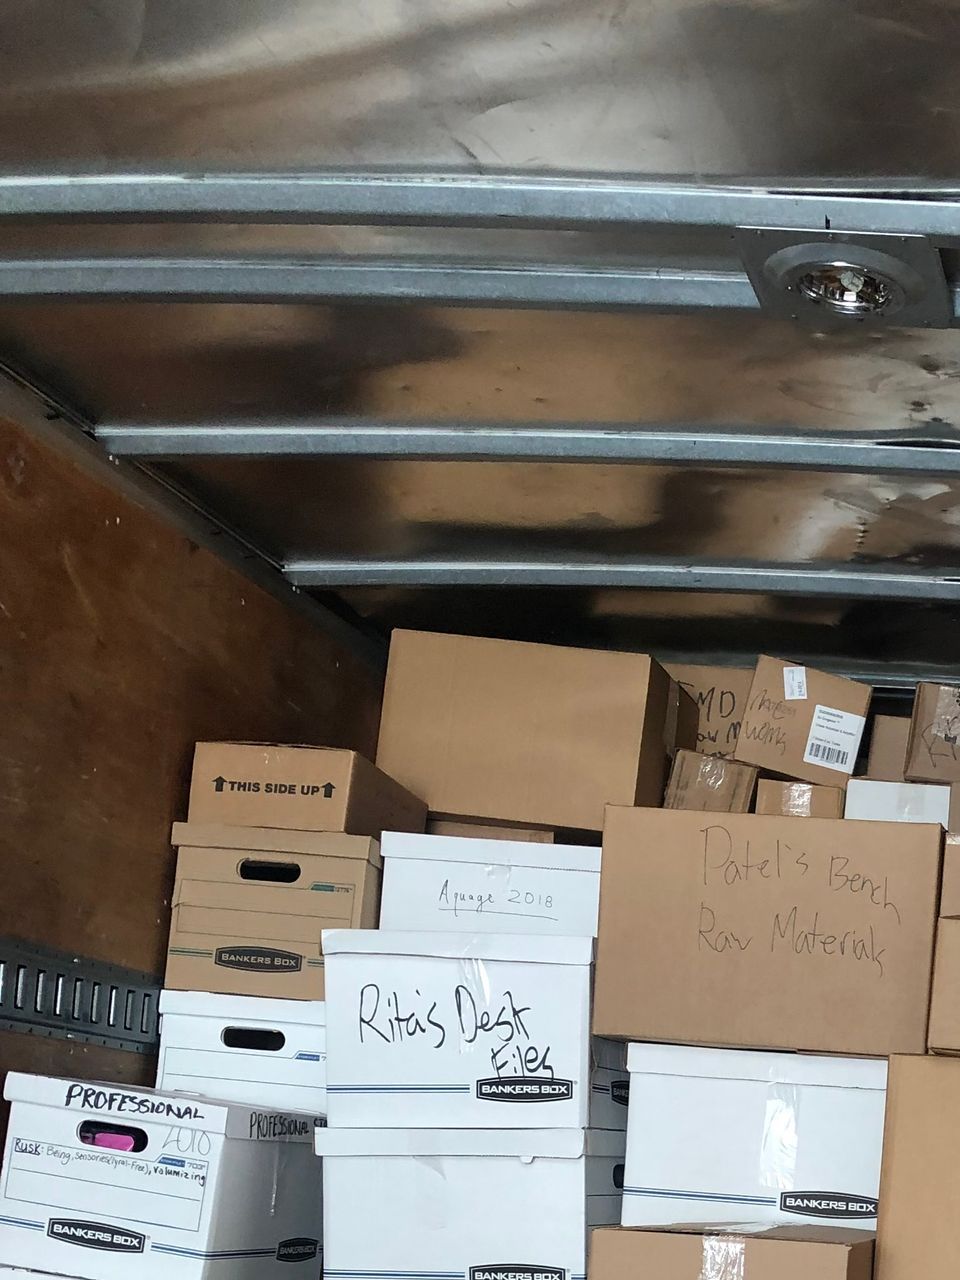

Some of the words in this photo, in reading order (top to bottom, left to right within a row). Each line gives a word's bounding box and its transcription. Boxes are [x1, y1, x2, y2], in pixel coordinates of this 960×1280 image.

[228, 780, 260, 793] THIS
[264, 782, 296, 794] SIDE
[300, 784, 320, 796] UP
[700, 825, 808, 886] Patel's
[438, 879, 495, 916] Aquage
[507, 889, 553, 908] 2018
[221, 952, 271, 965] BANKERS
[274, 955, 296, 967] BOX
[360, 983, 446, 1048] Rita's
[455, 984, 531, 1043] Desk
[491, 1042, 554, 1082] Files
[65, 1083, 205, 1120] PROFESSIONAL
[481, 1085, 539, 1095] BANKERS
[541, 1085, 568, 1095] BOX
[249, 1111, 310, 1139] PROFESSIONAL
[786, 1197, 846, 1210] BANKERS
[848, 1201, 876, 1213] BOX
[53, 1223, 112, 1243] BANKERS
[113, 1232, 140, 1248] BOX
